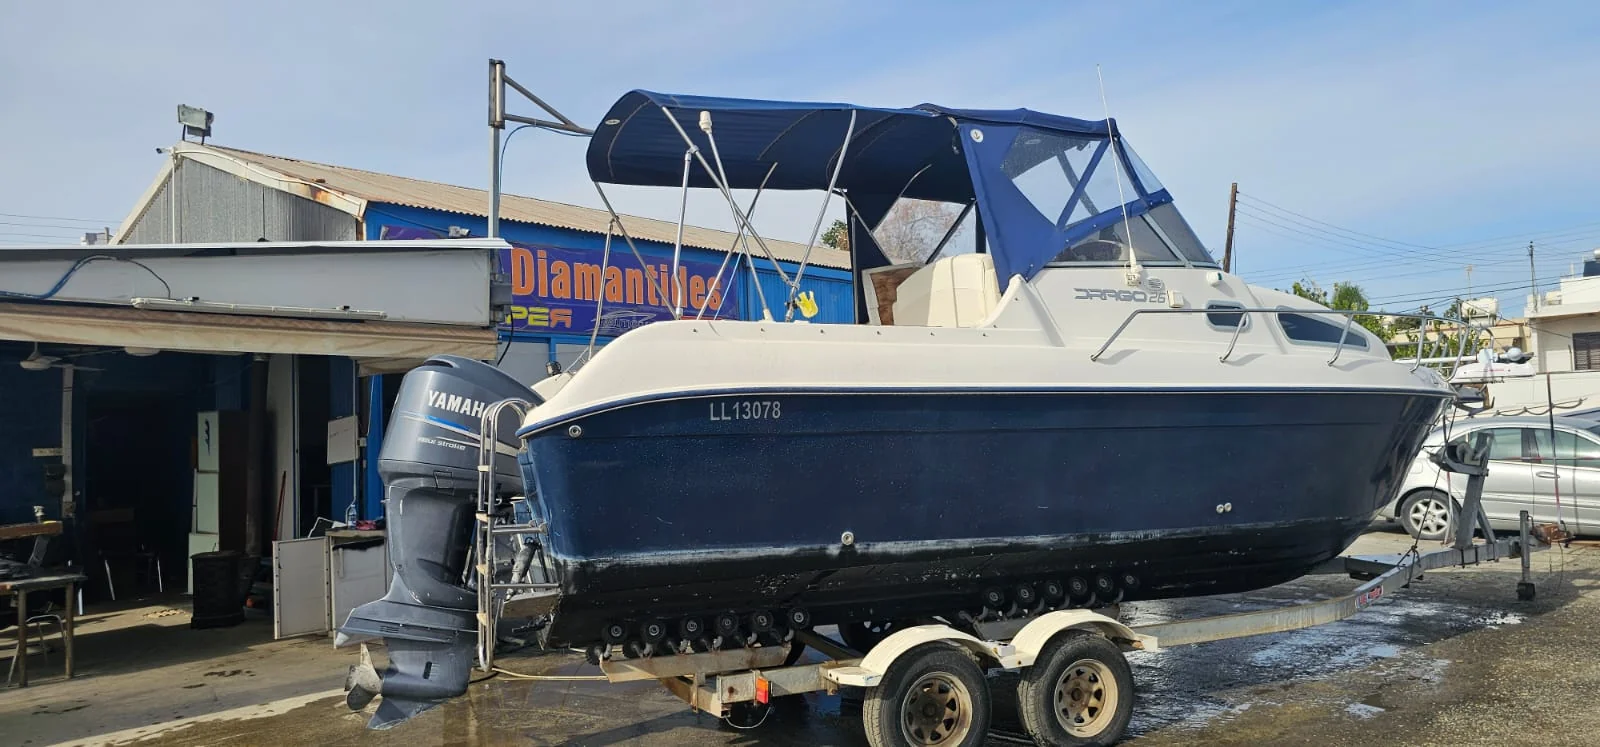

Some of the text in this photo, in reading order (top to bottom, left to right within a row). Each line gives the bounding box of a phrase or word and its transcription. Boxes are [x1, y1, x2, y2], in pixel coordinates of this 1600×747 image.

[511, 247, 722, 311] Diamantides
[1074, 288, 1166, 304] DRAGO 26
[427, 389, 492, 420] YAMAH
[709, 401, 781, 421] LL13078
